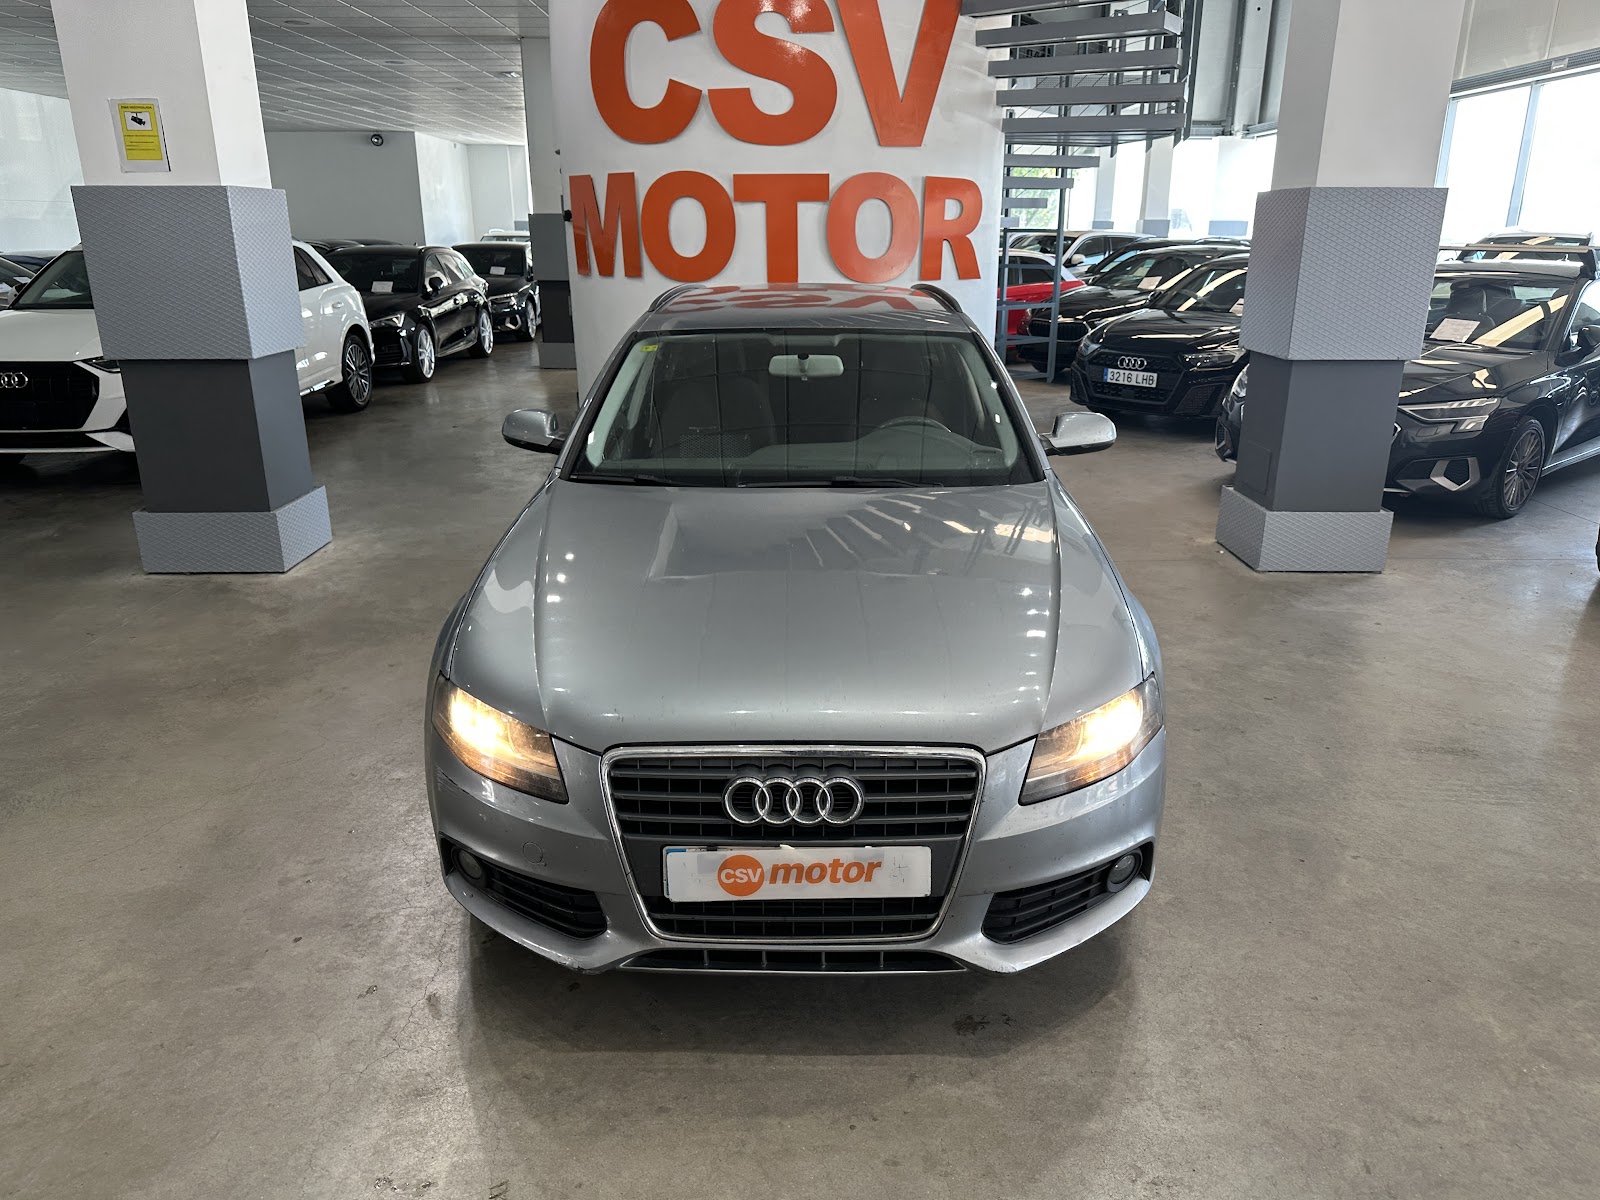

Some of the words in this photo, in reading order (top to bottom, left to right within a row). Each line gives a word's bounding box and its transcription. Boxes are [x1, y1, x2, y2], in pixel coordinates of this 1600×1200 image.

[590, 0, 961, 147] CSV
[568, 171, 983, 284] MOTOR
[1109, 371, 1133, 383] 3216
[1135, 373, 1155, 385] LHB
[720, 867, 762, 885] CSV
[768, 858, 882, 885] motor
